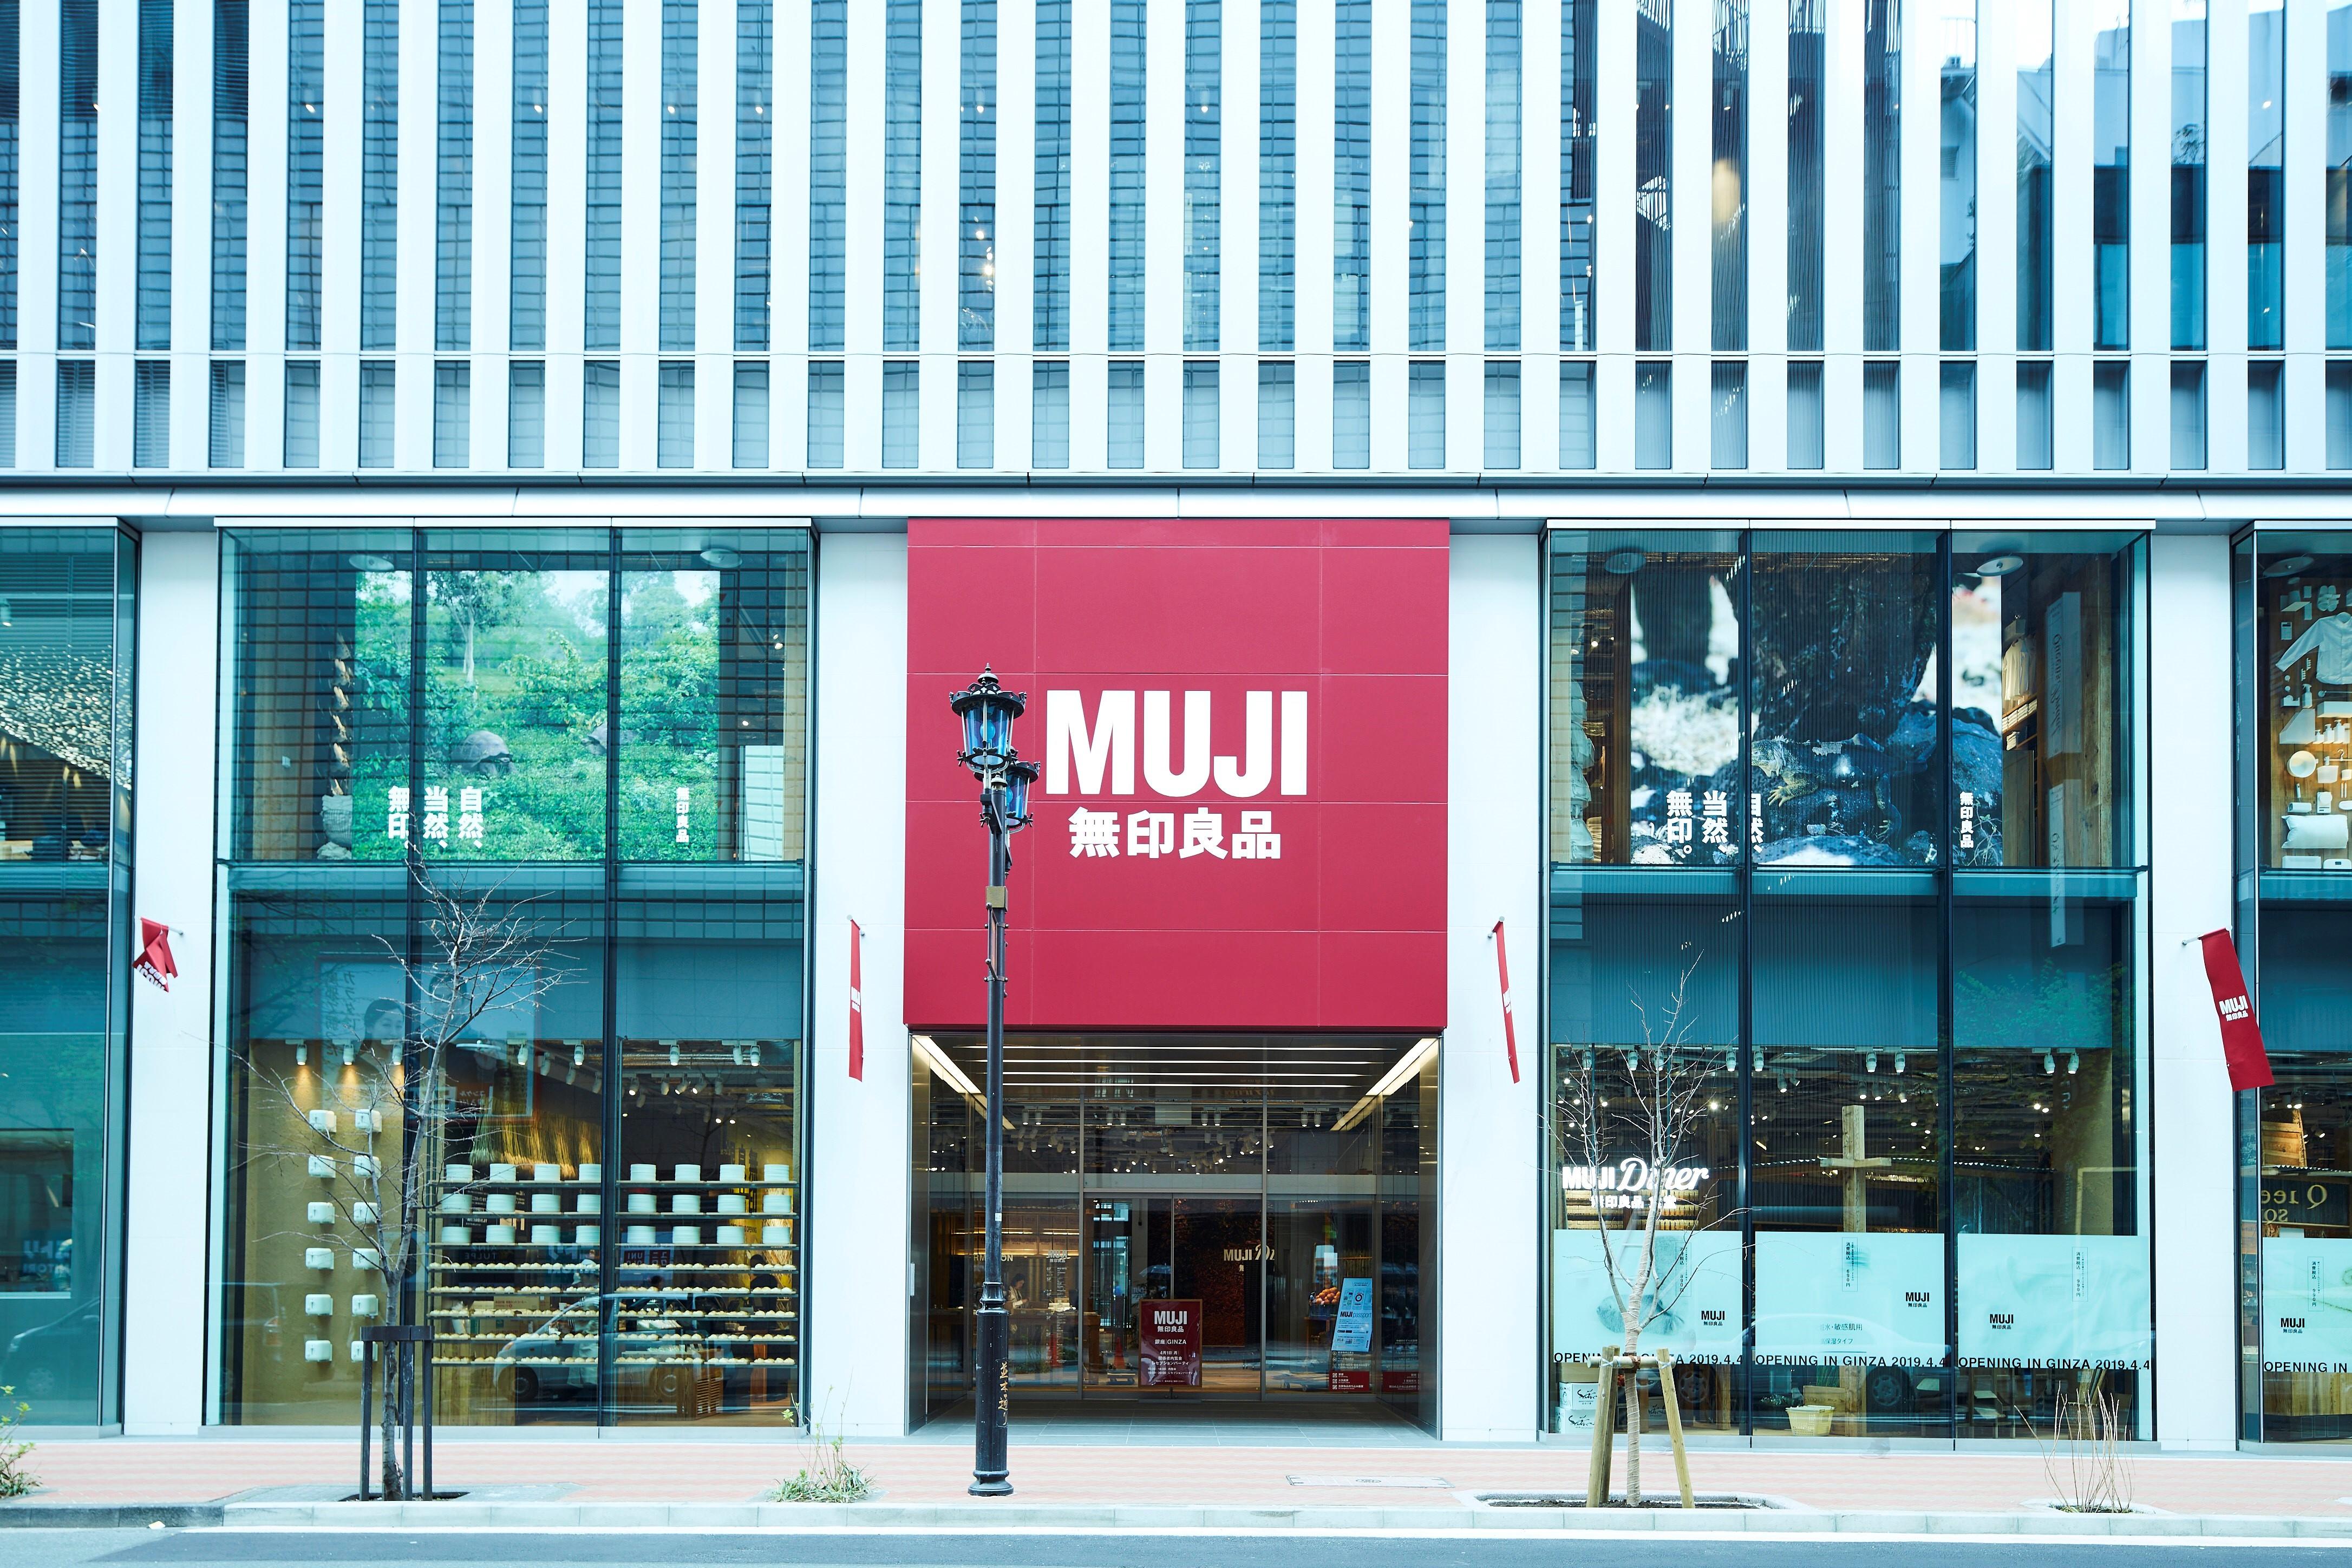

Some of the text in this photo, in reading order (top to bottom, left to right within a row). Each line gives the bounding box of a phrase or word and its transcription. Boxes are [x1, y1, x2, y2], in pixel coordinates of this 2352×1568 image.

[1046, 690, 1308, 798] MUJI
[423, 786, 449, 848] 当然、
[458, 786, 484, 848] 自然、
[676, 787, 689, 842] 無印良品
[1959, 792, 1974, 848] 無印良品
[1666, 790, 1693, 854] 無印。
[1702, 790, 1728, 853] 当然、
[1068, 807, 1281, 859] 無印良品
[2219, 995, 2248, 1015] MUJI
[2226, 1010, 2248, 1021] 無印良品
[1562, 1166, 1615, 1190] MUJI
[1590, 1194, 1644, 1209] 無印良品
[1048, 1250, 1068, 1258] MUJI
[1224, 1249, 1252, 1260] MUJI
[1905, 1292, 1930, 1302] MUJI
[1154, 1311, 1187, 1324] MUJI
[1701, 1310, 1725, 1321] MUJI
[1990, 1314, 2014, 1324] MUJI
[2281, 1318, 2305, 1328] MUJI
[1690, 1354, 1743, 1364] 2019.4.4
[1755, 1355, 1945, 1368] OPENING IN GINZA 2019.4.4
[1958, 1357, 2150, 1370] OPENING IN GINZA 2019.4.4
[2264, 1361, 2347, 1373] OPENING IN
